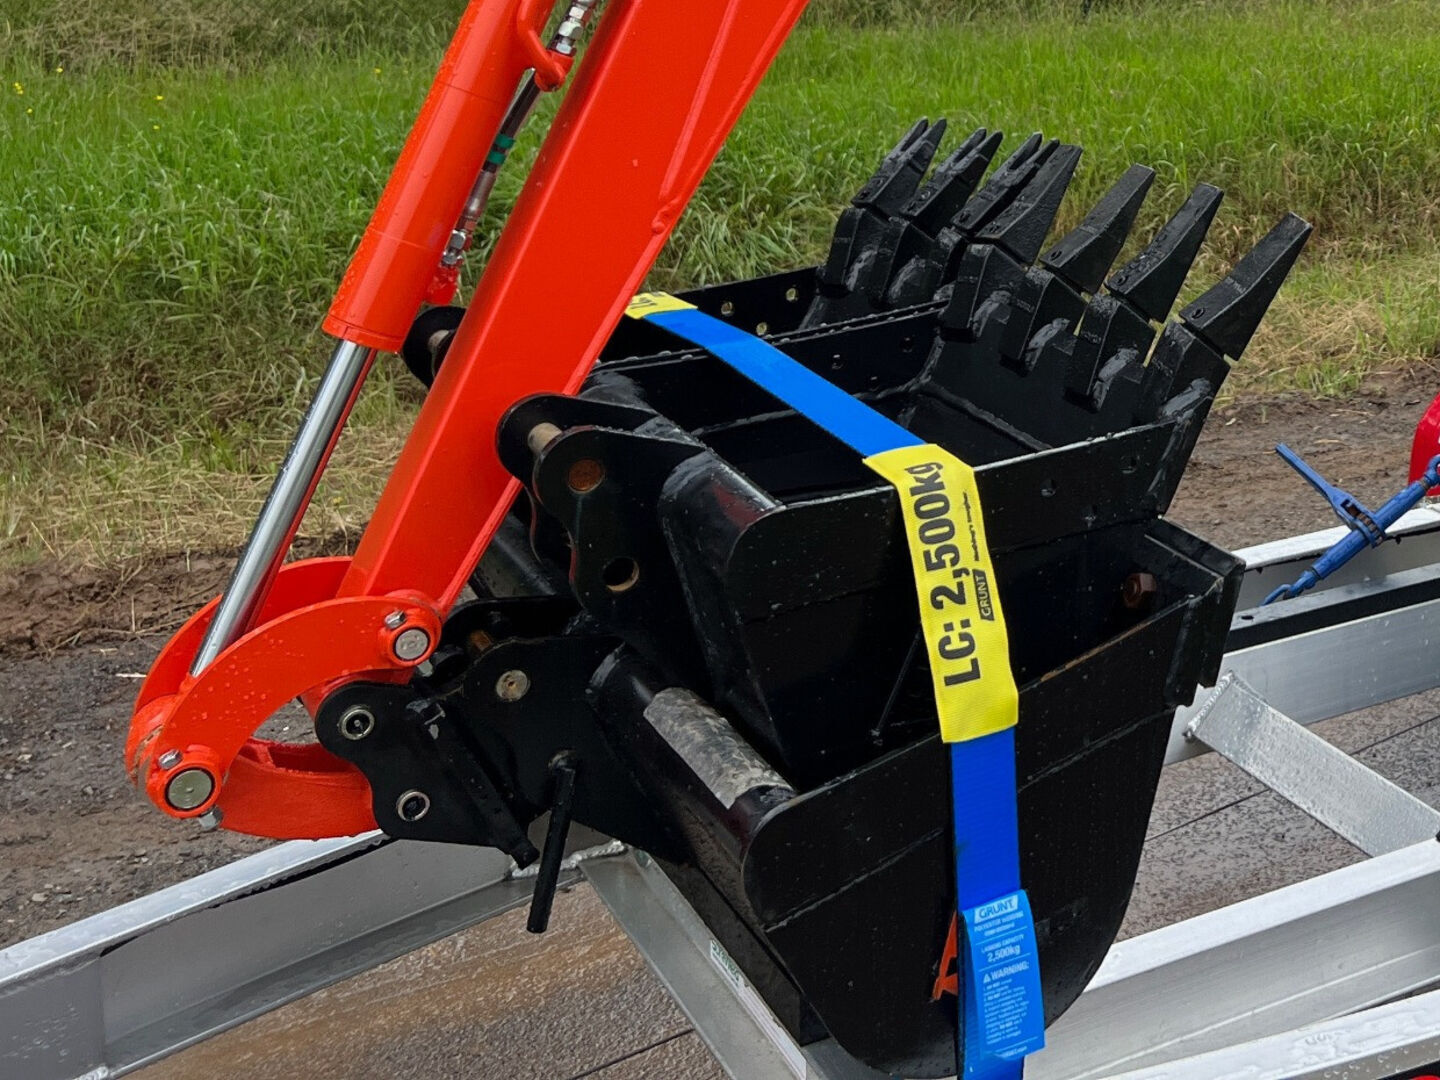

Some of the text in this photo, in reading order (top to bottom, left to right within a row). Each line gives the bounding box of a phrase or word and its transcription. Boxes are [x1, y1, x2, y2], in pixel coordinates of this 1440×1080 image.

[904, 461, 982, 687] LC: 2,500kg
[975, 575, 992, 617] GRUNT
[979, 899, 1015, 919] GRUNT
[987, 945, 1021, 963] 2,500kg
[991, 960, 1030, 980] WARNING:
